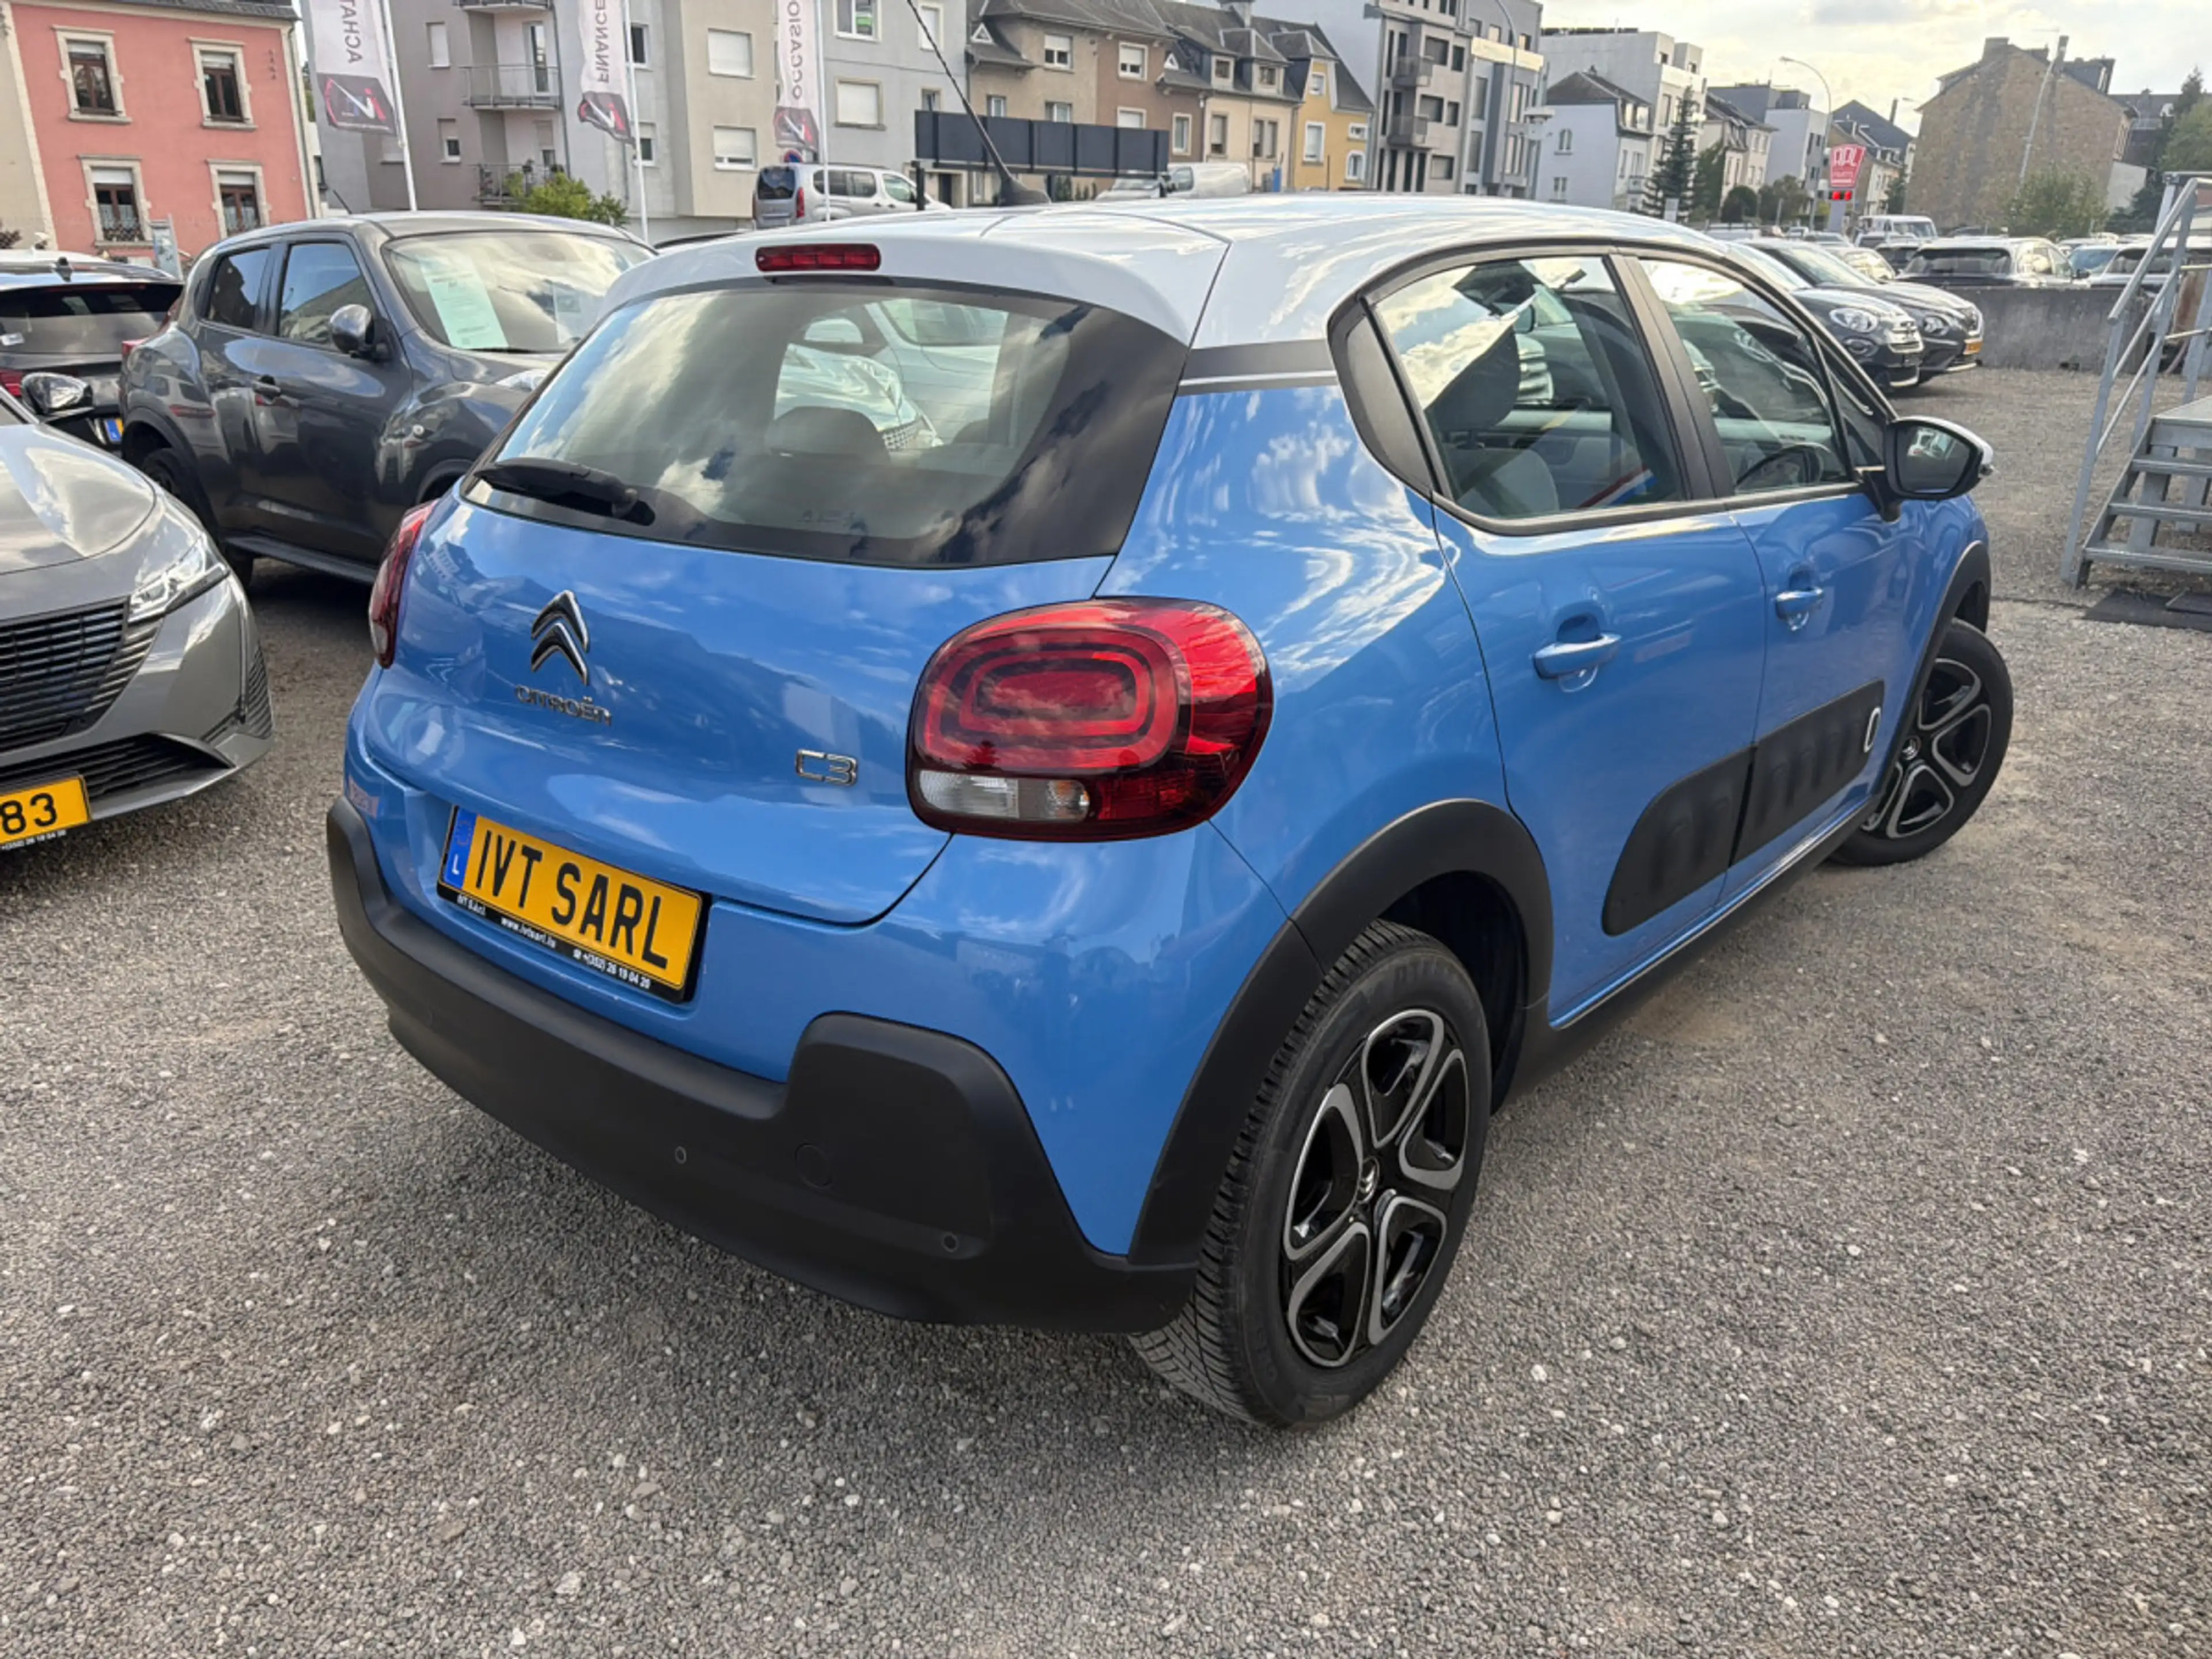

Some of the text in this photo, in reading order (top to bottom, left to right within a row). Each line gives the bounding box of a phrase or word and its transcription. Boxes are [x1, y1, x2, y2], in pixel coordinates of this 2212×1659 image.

[795, 748, 858, 786] C3
[475, 829, 668, 970] IVT SARL
